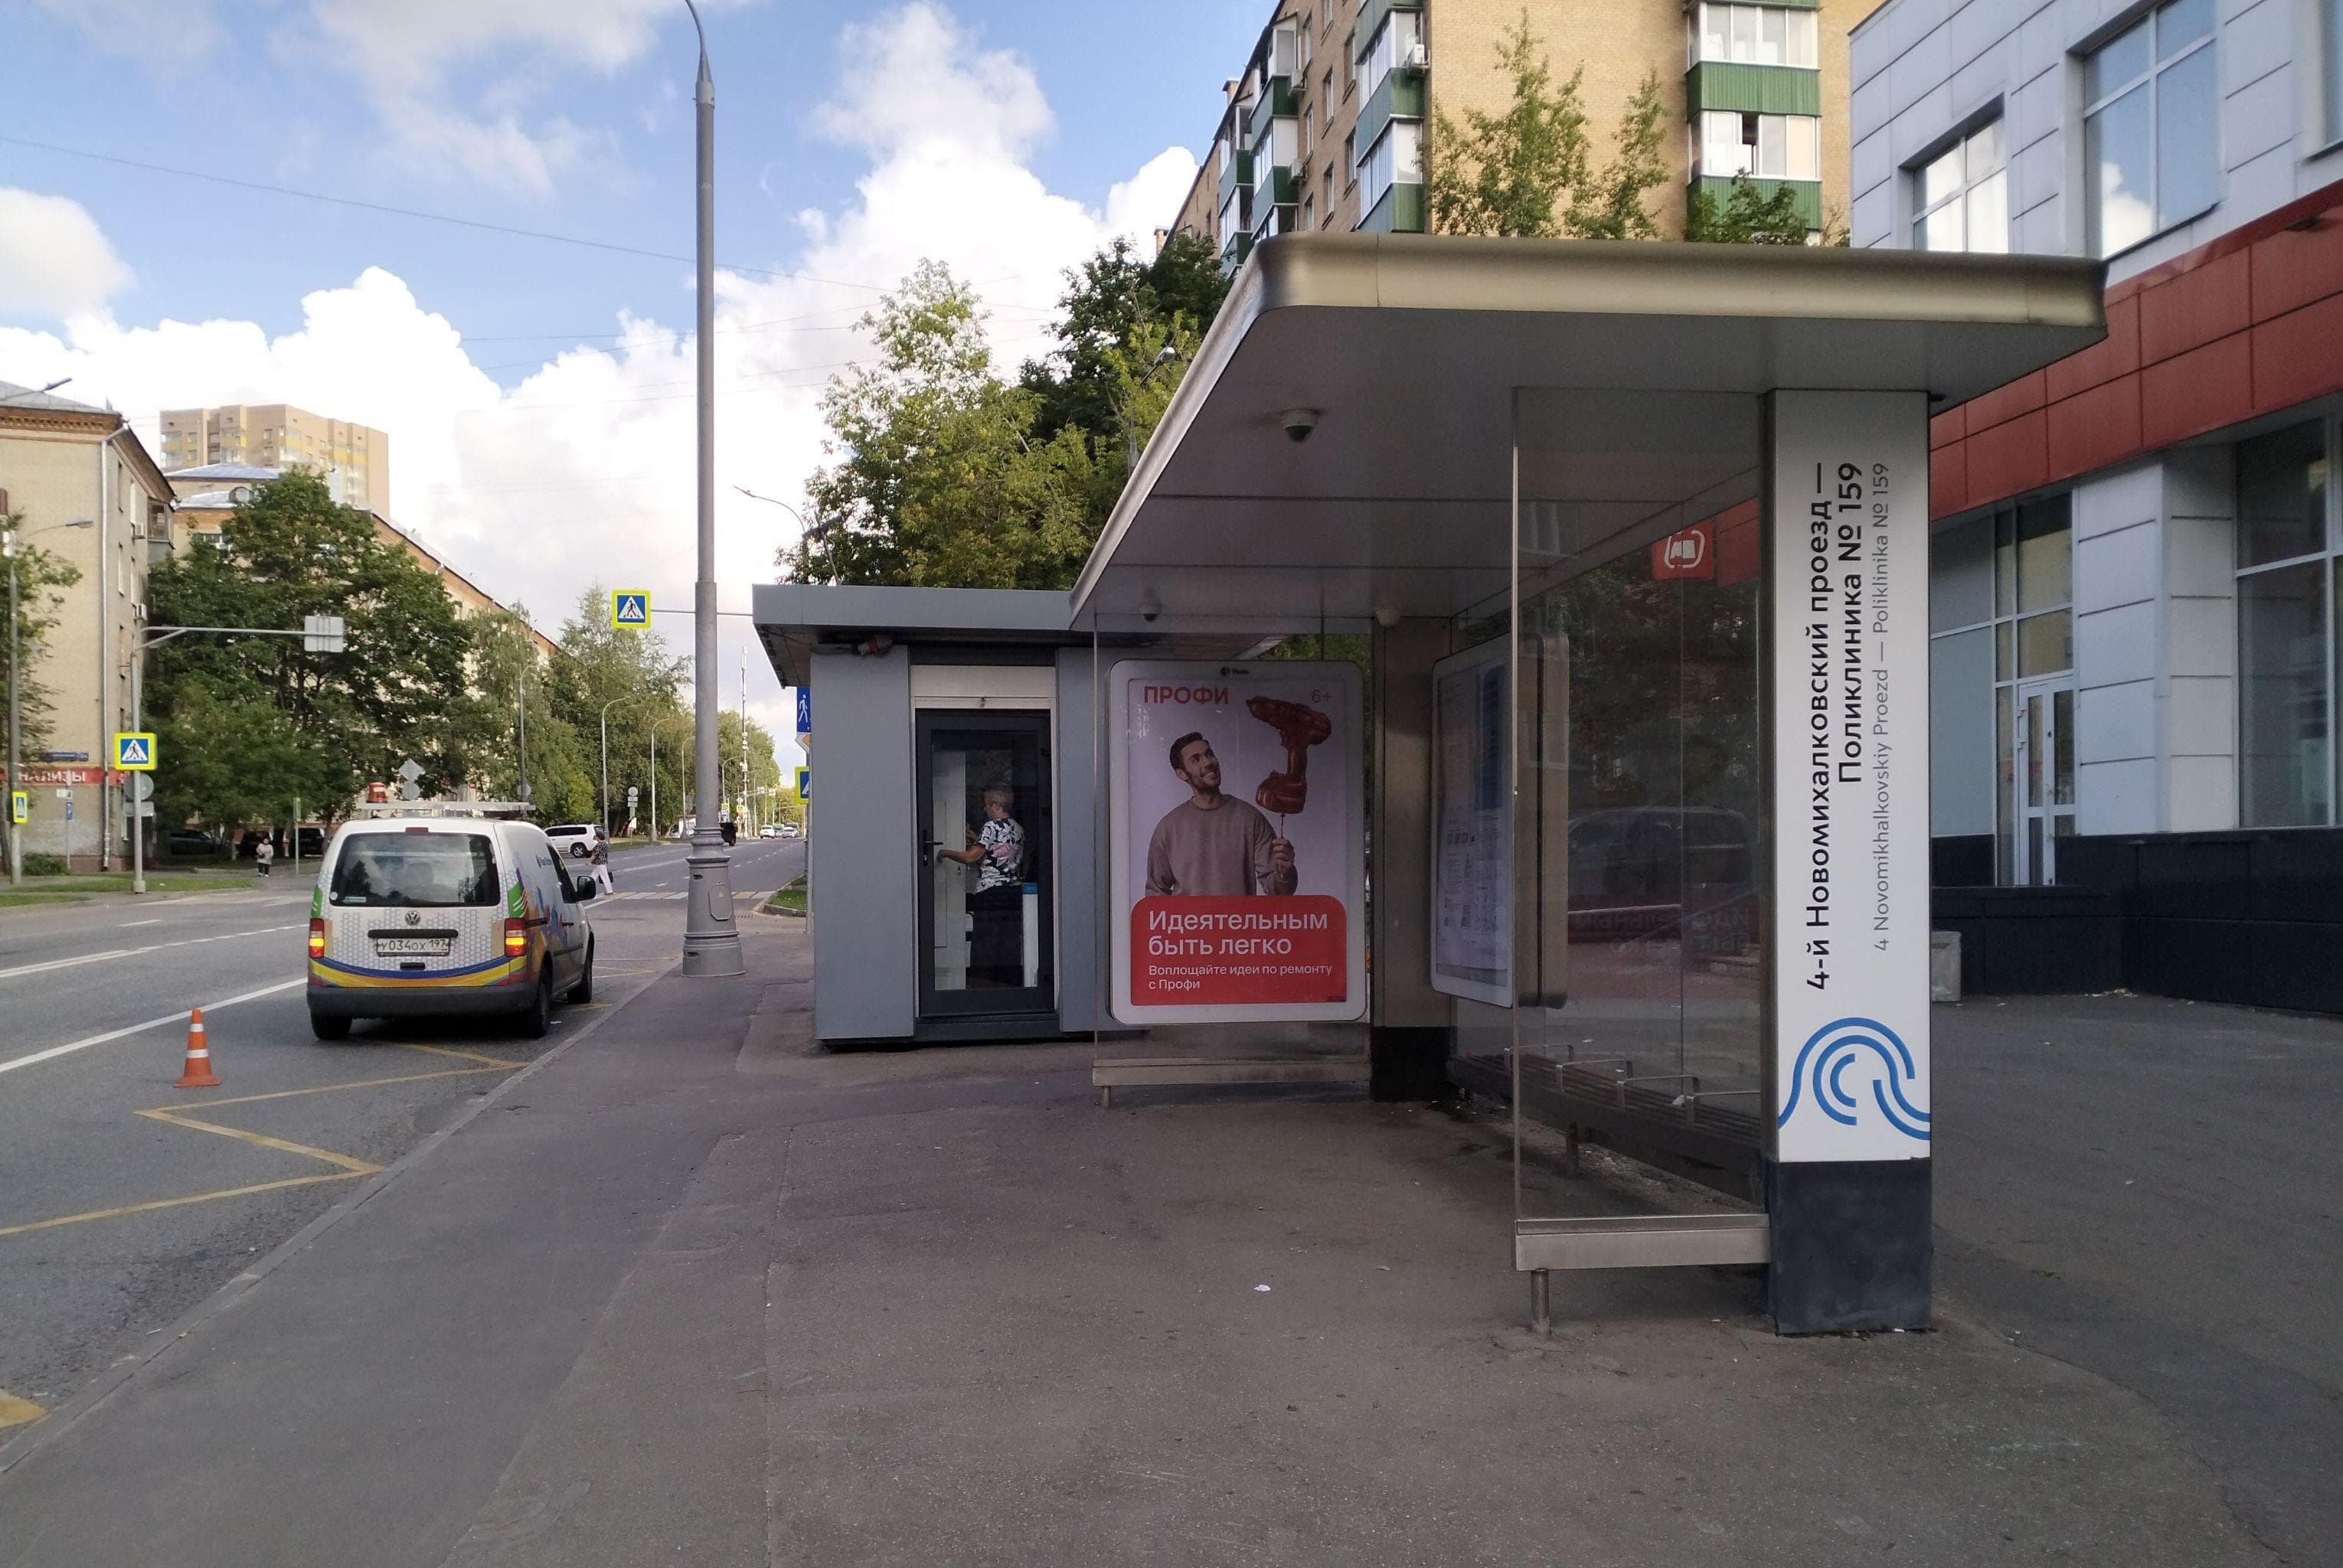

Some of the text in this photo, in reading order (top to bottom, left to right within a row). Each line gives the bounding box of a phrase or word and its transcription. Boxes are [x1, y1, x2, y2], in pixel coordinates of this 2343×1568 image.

[1838, 463, 1861, 512] 159
[1873, 463, 1888, 495] 159
[1811, 501, 1834, 612] проезд
[1872, 536, 1888, 632] Poliklinika
[1144, 686, 1229, 704] ПРОФИ
[1311, 689, 1332, 703] 6+
[1838, 575, 1861, 782] Поликлиника
[1872, 670, 1888, 735] Proezd
[1805, 624, 1829, 926] Новомихалковский
[1873, 743, 1892, 930] Novomikhalkovskiy
[1149, 910, 1328, 933] Идеятельным
[1149, 936, 1292, 955] быть легко
[1806, 940, 1829, 989] 4-й
[1874, 939, 1889, 951] 4
[1149, 965, 1332, 976] Воплощайте идеи по ремонту
[1159, 979, 1201, 991] Профи
